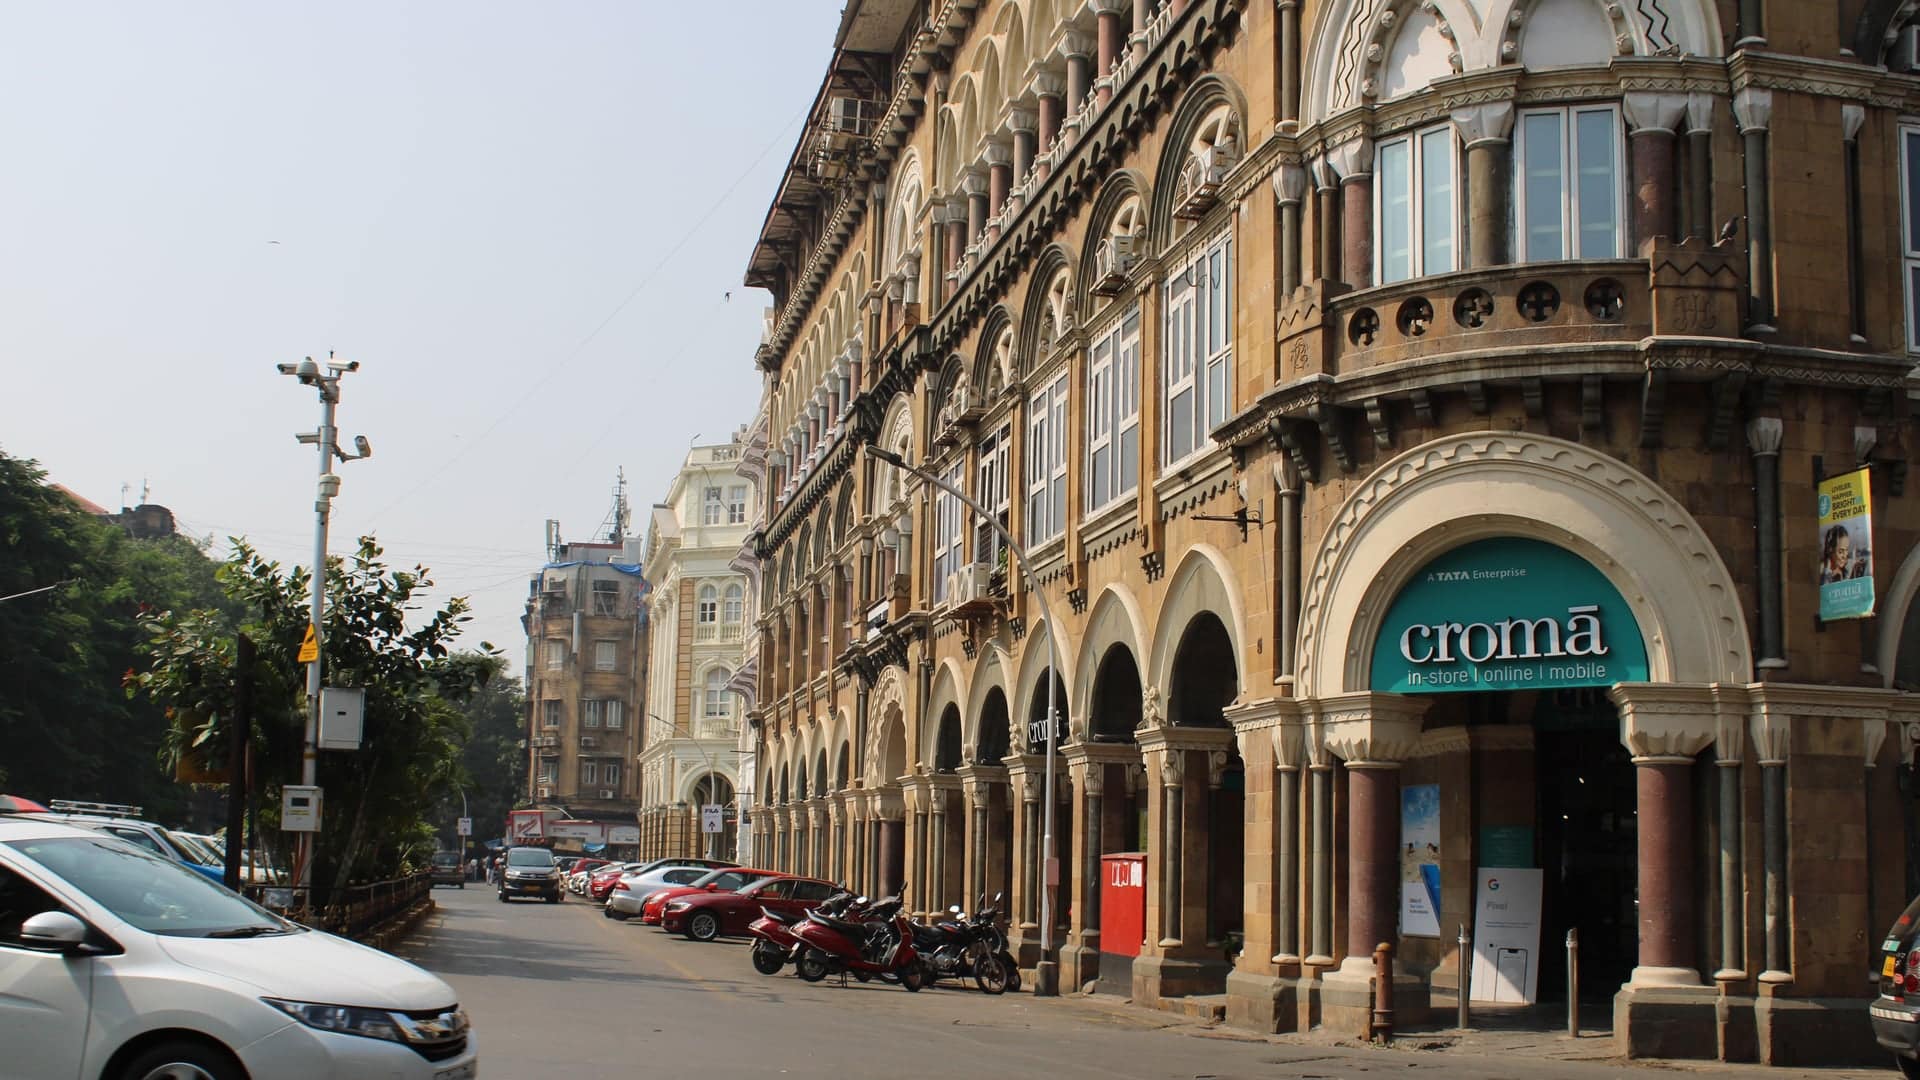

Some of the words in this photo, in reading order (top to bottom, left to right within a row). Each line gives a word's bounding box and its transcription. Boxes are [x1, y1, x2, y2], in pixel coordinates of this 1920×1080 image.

[1832, 508, 1852, 521] EVERY
[1852, 504, 1867, 515] DAY
[1427, 573, 1436, 582] A
[1436, 571, 1471, 582] TATA
[1472, 567, 1527, 581] Enterprise
[1407, 667, 1469, 686] in-store
[1483, 664, 1533, 683] online
[1549, 662, 1606, 681] mobile
